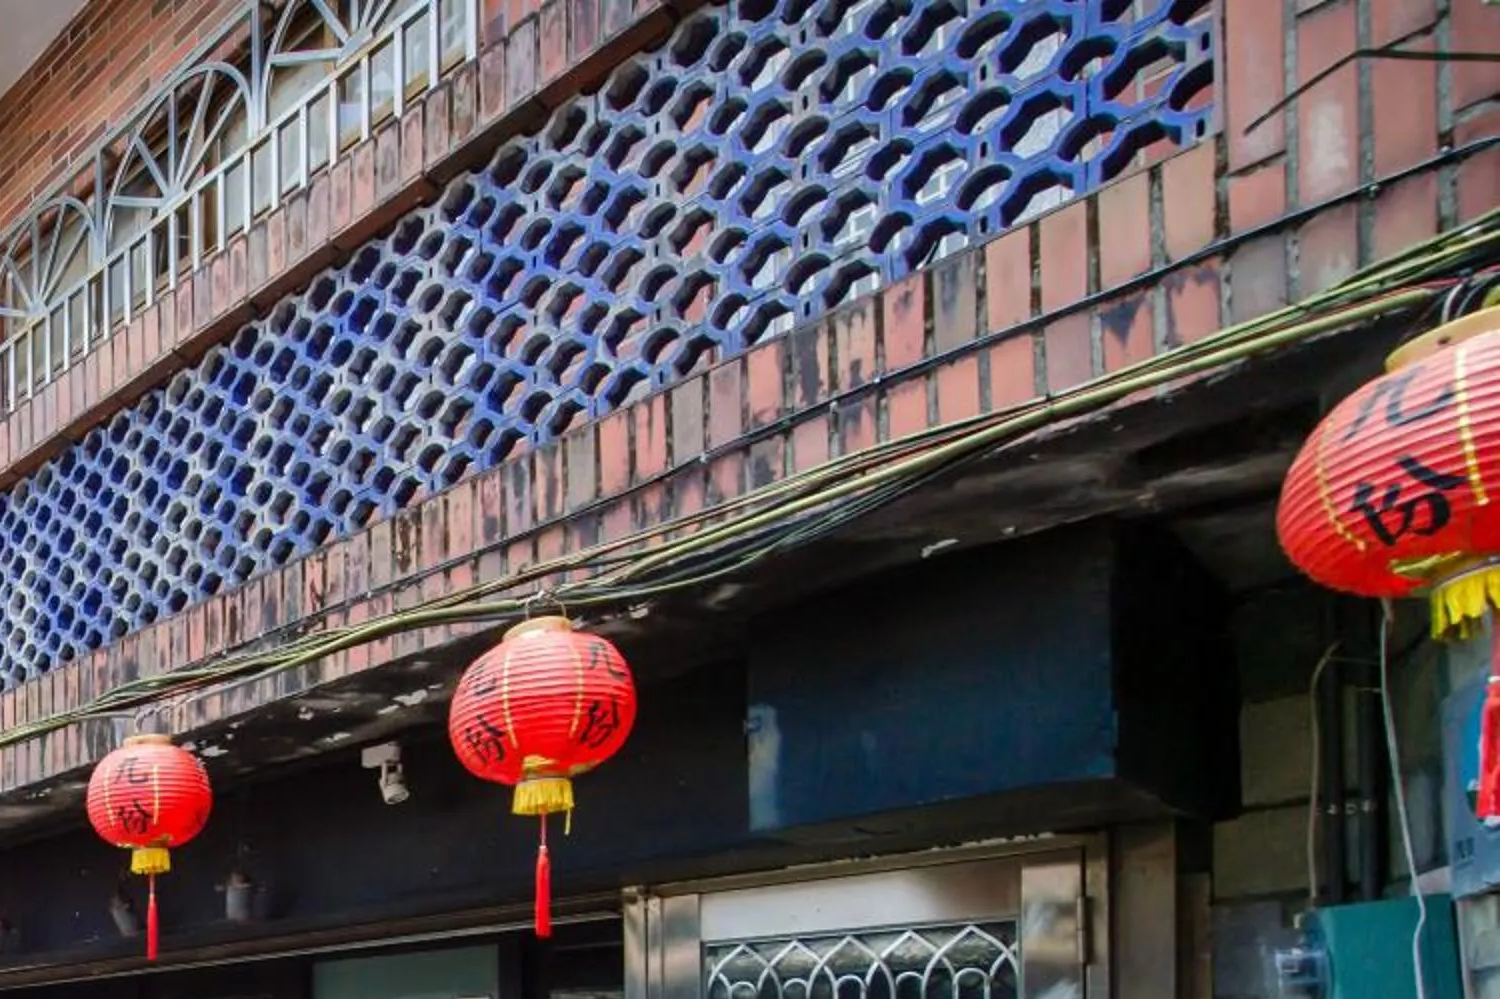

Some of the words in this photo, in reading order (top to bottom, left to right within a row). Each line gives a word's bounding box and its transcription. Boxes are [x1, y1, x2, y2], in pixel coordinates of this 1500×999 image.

[1344, 364, 1469, 547] 九份
[580, 641, 629, 749] 九份
[113, 756, 154, 835] 九份
